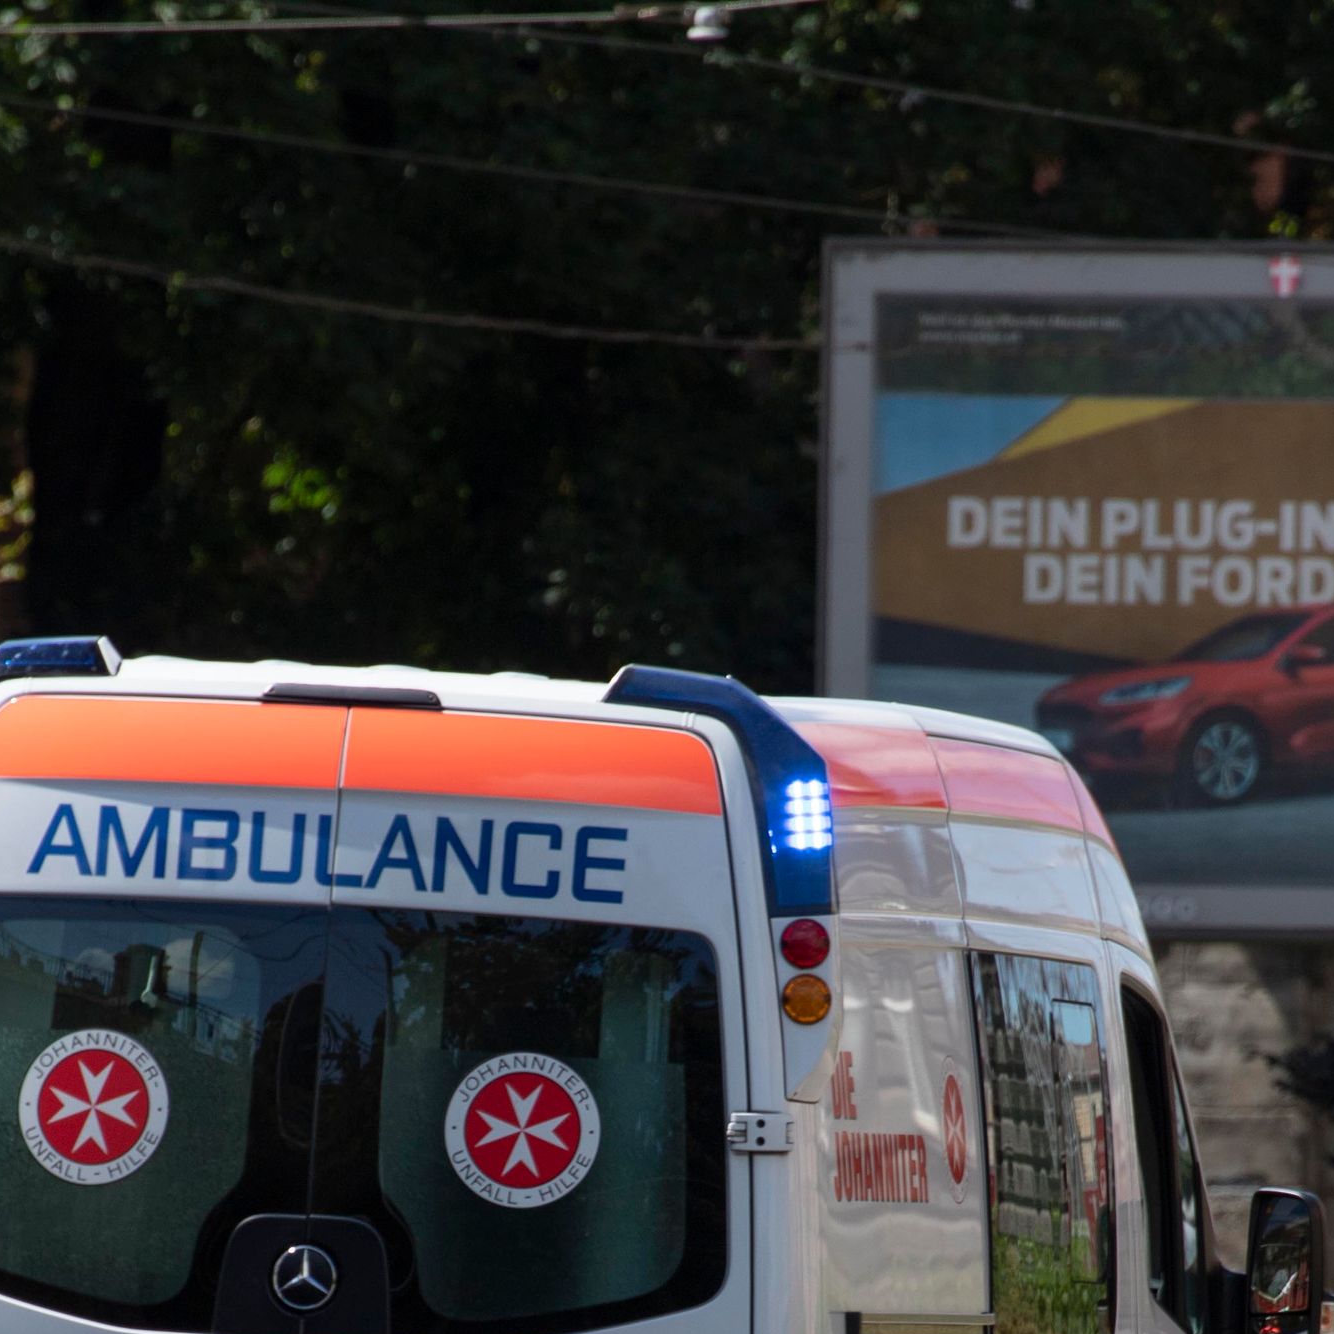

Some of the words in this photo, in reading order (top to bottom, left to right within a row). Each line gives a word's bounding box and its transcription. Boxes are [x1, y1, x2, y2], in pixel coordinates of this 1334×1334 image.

[946, 496, 1090, 549] DEIN
[1022, 552, 1165, 605] DEIN
[26, 803, 628, 905] AMBULANCE
[830, 1051, 858, 1121] DIE
[834, 1131, 930, 1204] JOHANNITER
